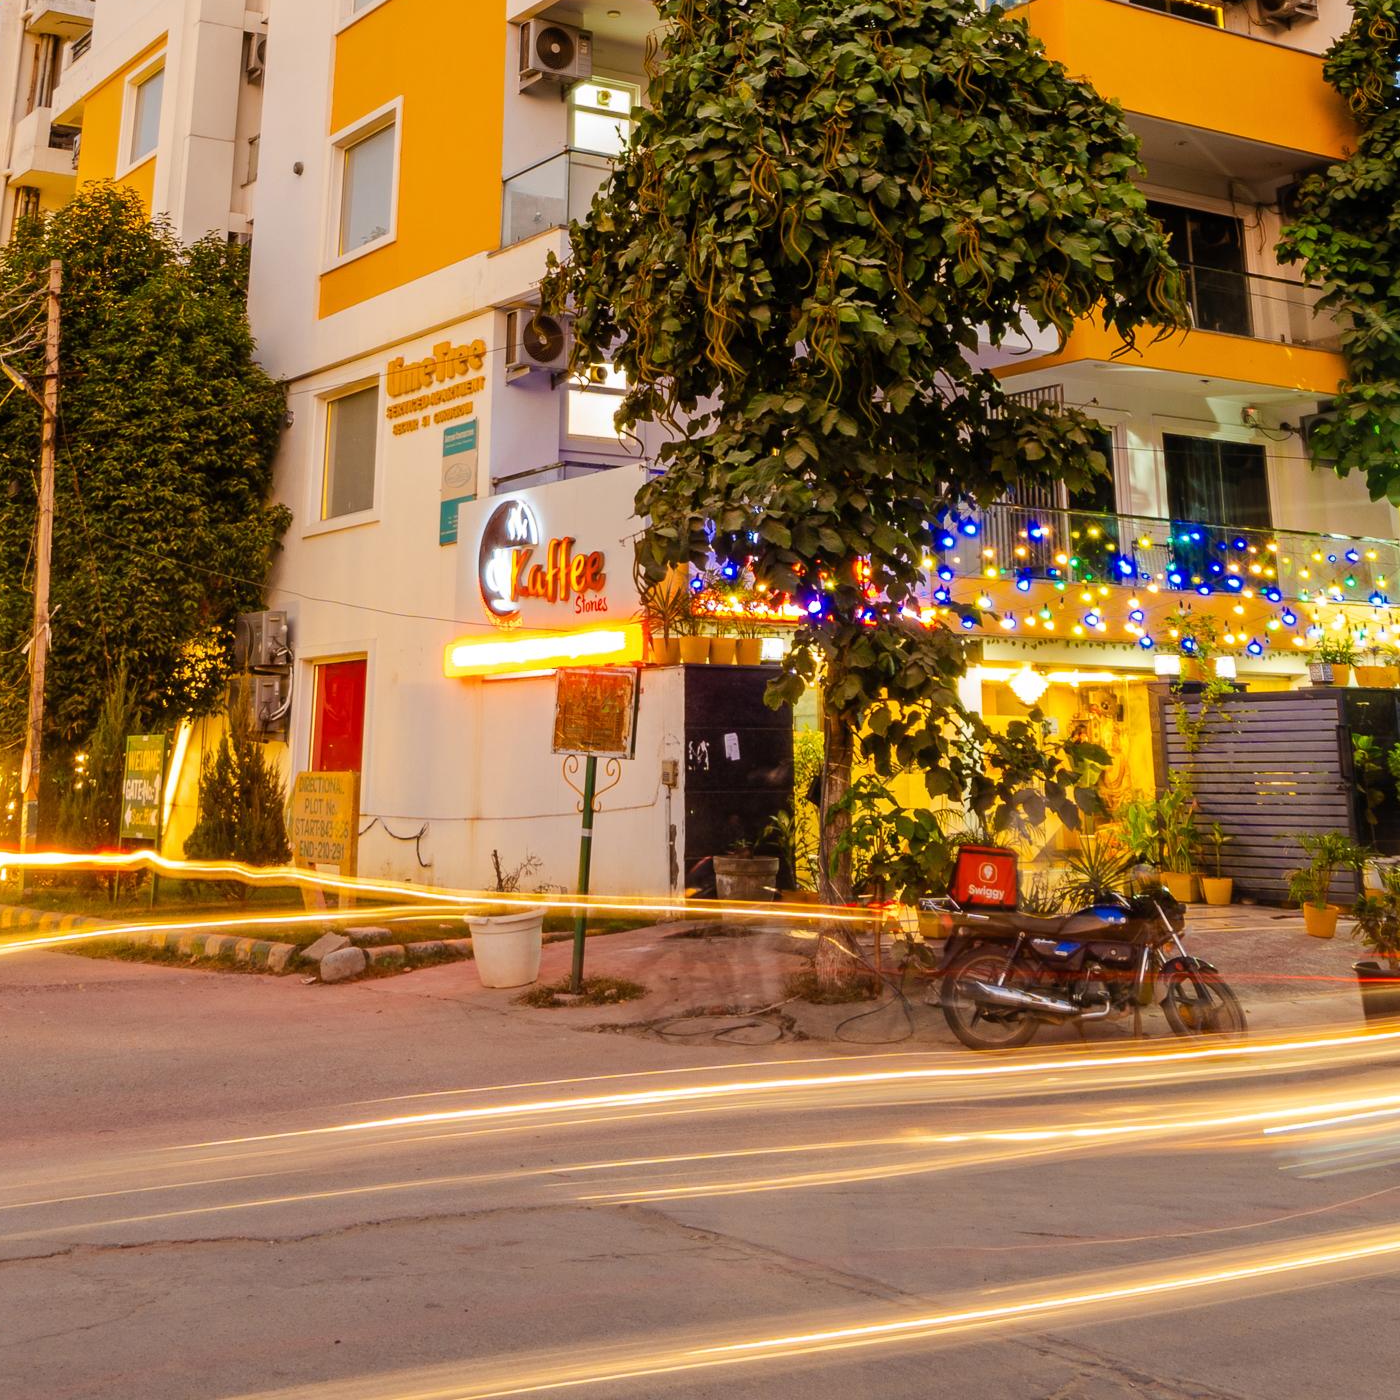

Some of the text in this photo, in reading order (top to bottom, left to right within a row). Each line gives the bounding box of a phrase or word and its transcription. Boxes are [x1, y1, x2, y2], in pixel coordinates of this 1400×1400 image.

[386, 375, 486, 420] SERVICED APARTMENT
[511, 537, 606, 603] Kaffee
[575, 595, 608, 614] Stories
[129, 750, 161, 771] WELCOME
[304, 798, 323, 815] PLOT
[968, 884, 1005, 900] Swiggy
